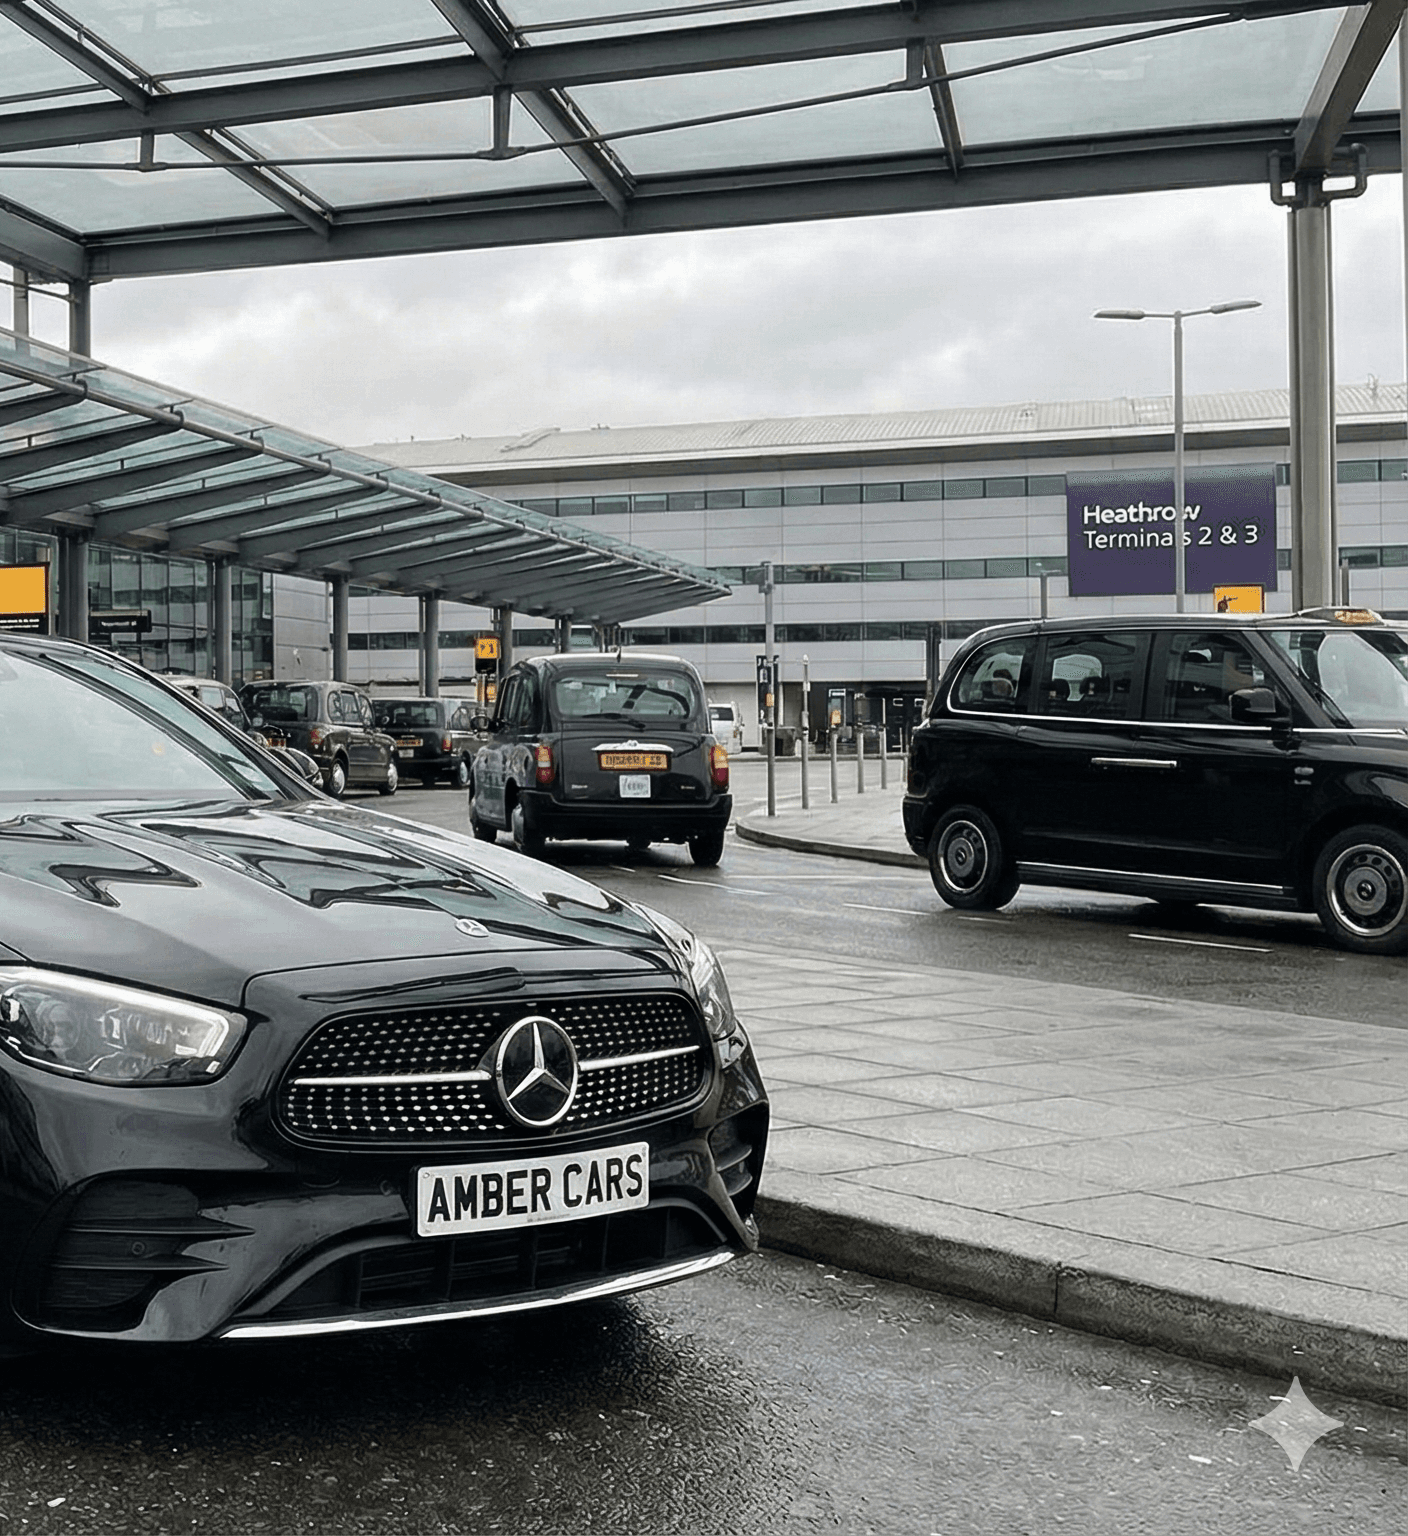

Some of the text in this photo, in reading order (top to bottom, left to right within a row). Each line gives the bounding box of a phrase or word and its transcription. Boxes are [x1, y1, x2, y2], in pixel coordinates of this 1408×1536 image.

[1083, 502, 1200, 524] Heathrow
[1083, 525, 1258, 549] Terminas 2 & 3
[427, 1153, 642, 1223] AMBER CARS
